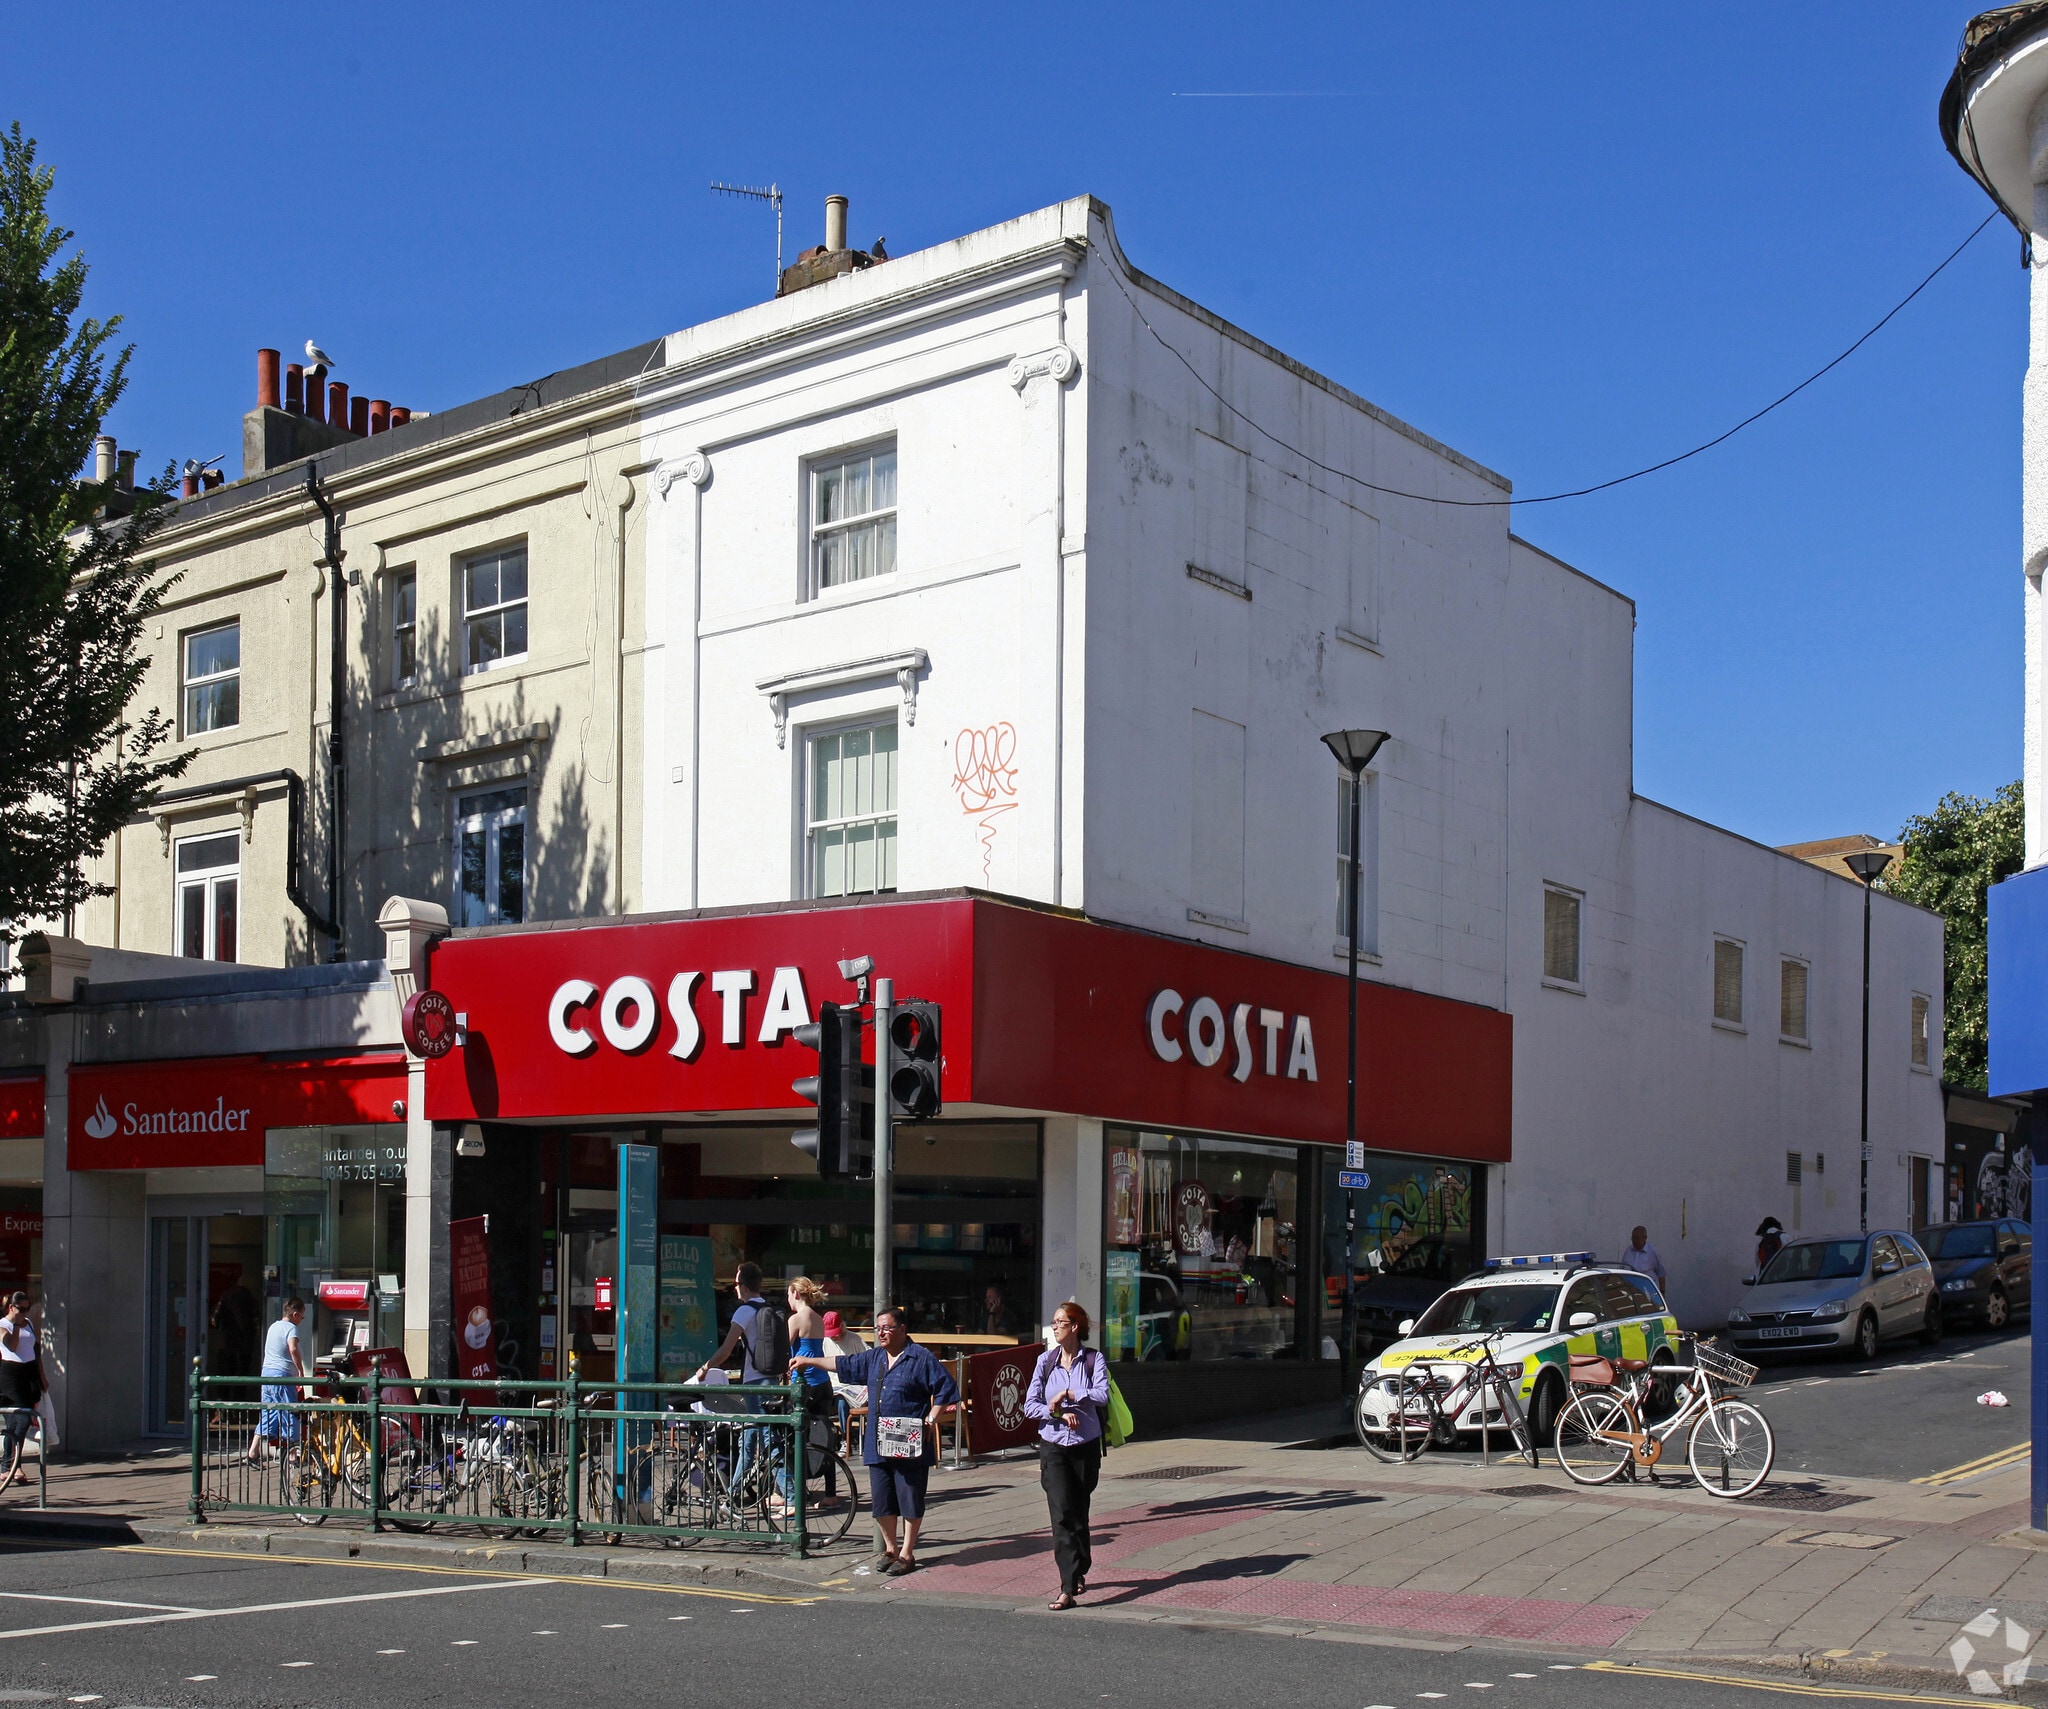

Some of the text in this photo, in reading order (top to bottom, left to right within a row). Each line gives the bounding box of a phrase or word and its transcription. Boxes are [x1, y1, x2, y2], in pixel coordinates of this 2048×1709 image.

[420, 997, 448, 1015] COSTA
[547, 966, 814, 1060] COSTA
[418, 1030, 451, 1052] COFFEE
[1145, 988, 1318, 1083] COSTA
[123, 1096, 250, 1136] Santander
[322, 1146, 407, 1161] antander.co.u
[1112, 1151, 1137, 1170] HELLO
[322, 1165, 351, 1180] 0845
[354, 1164, 376, 1180] 765
[1181, 1187, 1206, 1207] COSTA
[5, 1216, 43, 1234] Expre
[1179, 1224, 1204, 1249] COFF
[661, 1260, 682, 1273] OSTA
[333, 1287, 360, 1296] Santander
[1469, 1278, 1545, 1287] AMBULANCE
[1761, 1328, 1782, 1338] EX02
[368, 1353, 387, 1361] CTA
[995, 1367, 1021, 1389] COSTA
[995, 1402, 1025, 1429] COFFEE
